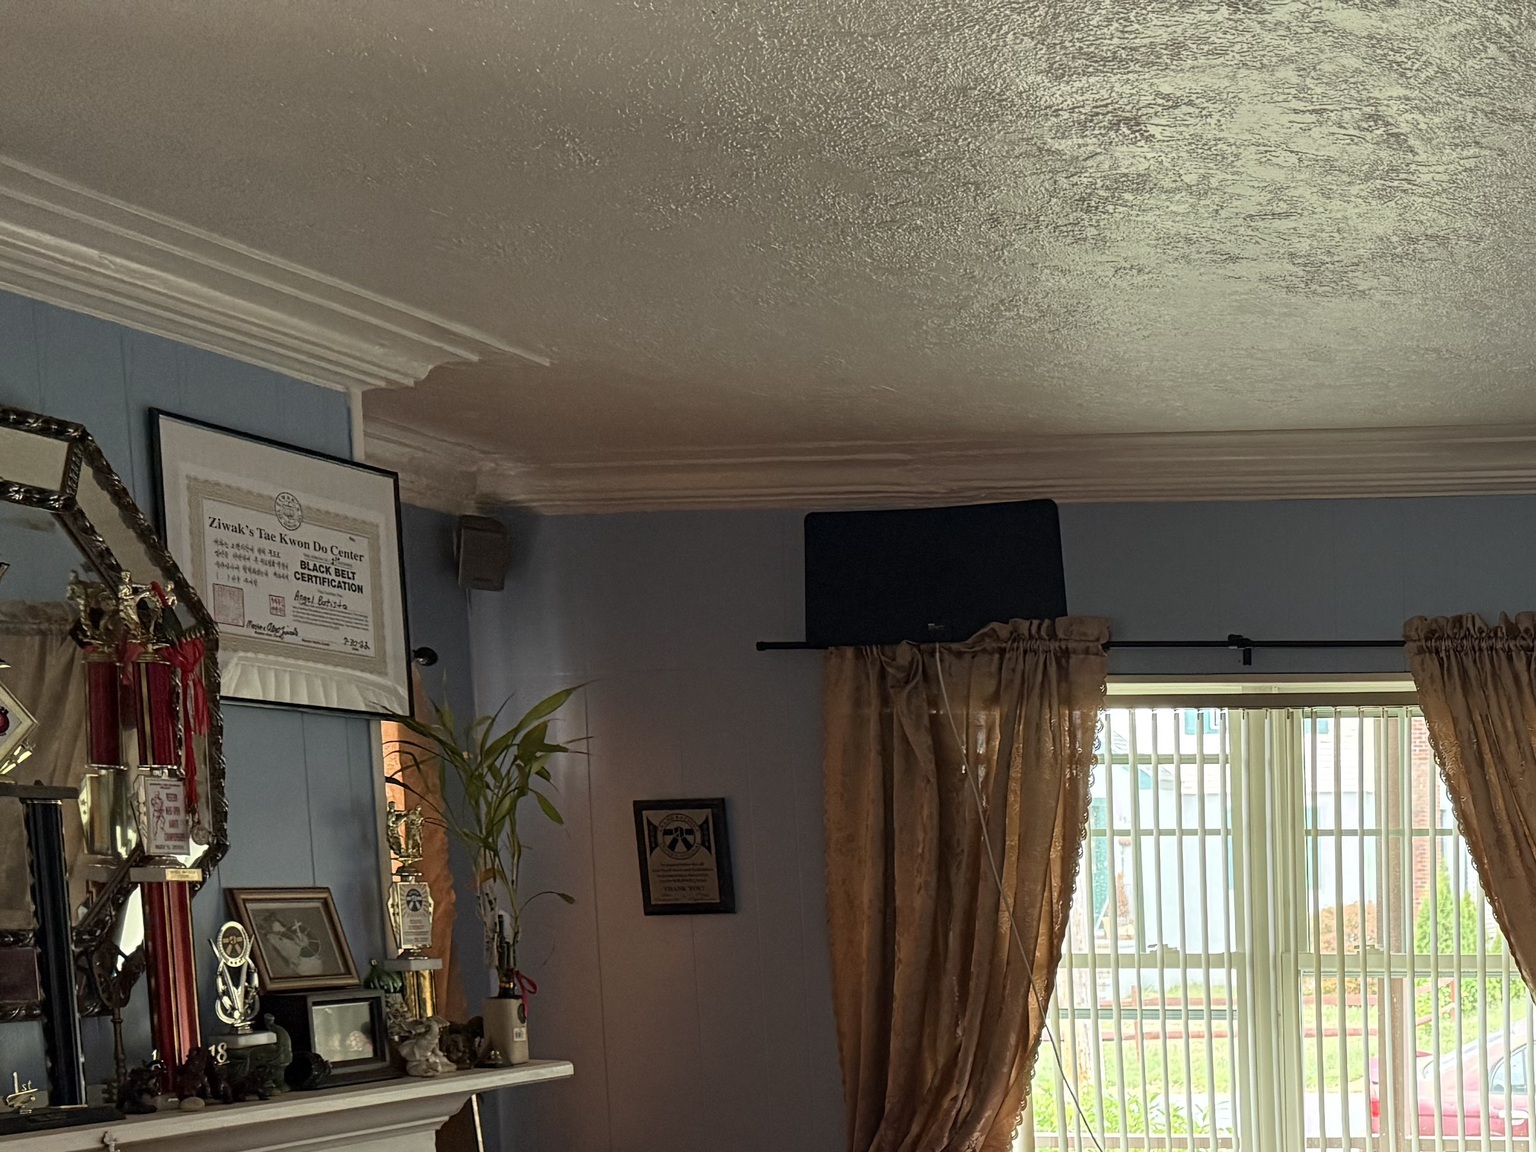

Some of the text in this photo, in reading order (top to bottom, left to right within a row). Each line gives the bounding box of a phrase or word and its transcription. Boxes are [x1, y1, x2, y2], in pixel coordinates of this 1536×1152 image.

[208, 516, 255, 537] Ziwak's
[256, 527, 277, 542] Tae
[279, 533, 310, 550] Kwon
[313, 541, 328, 554] Do
[330, 545, 364, 562] Center
[300, 560, 332, 576] BLACK
[334, 567, 356, 580] BELT
[294, 571, 364, 594] CERTIFICATION
